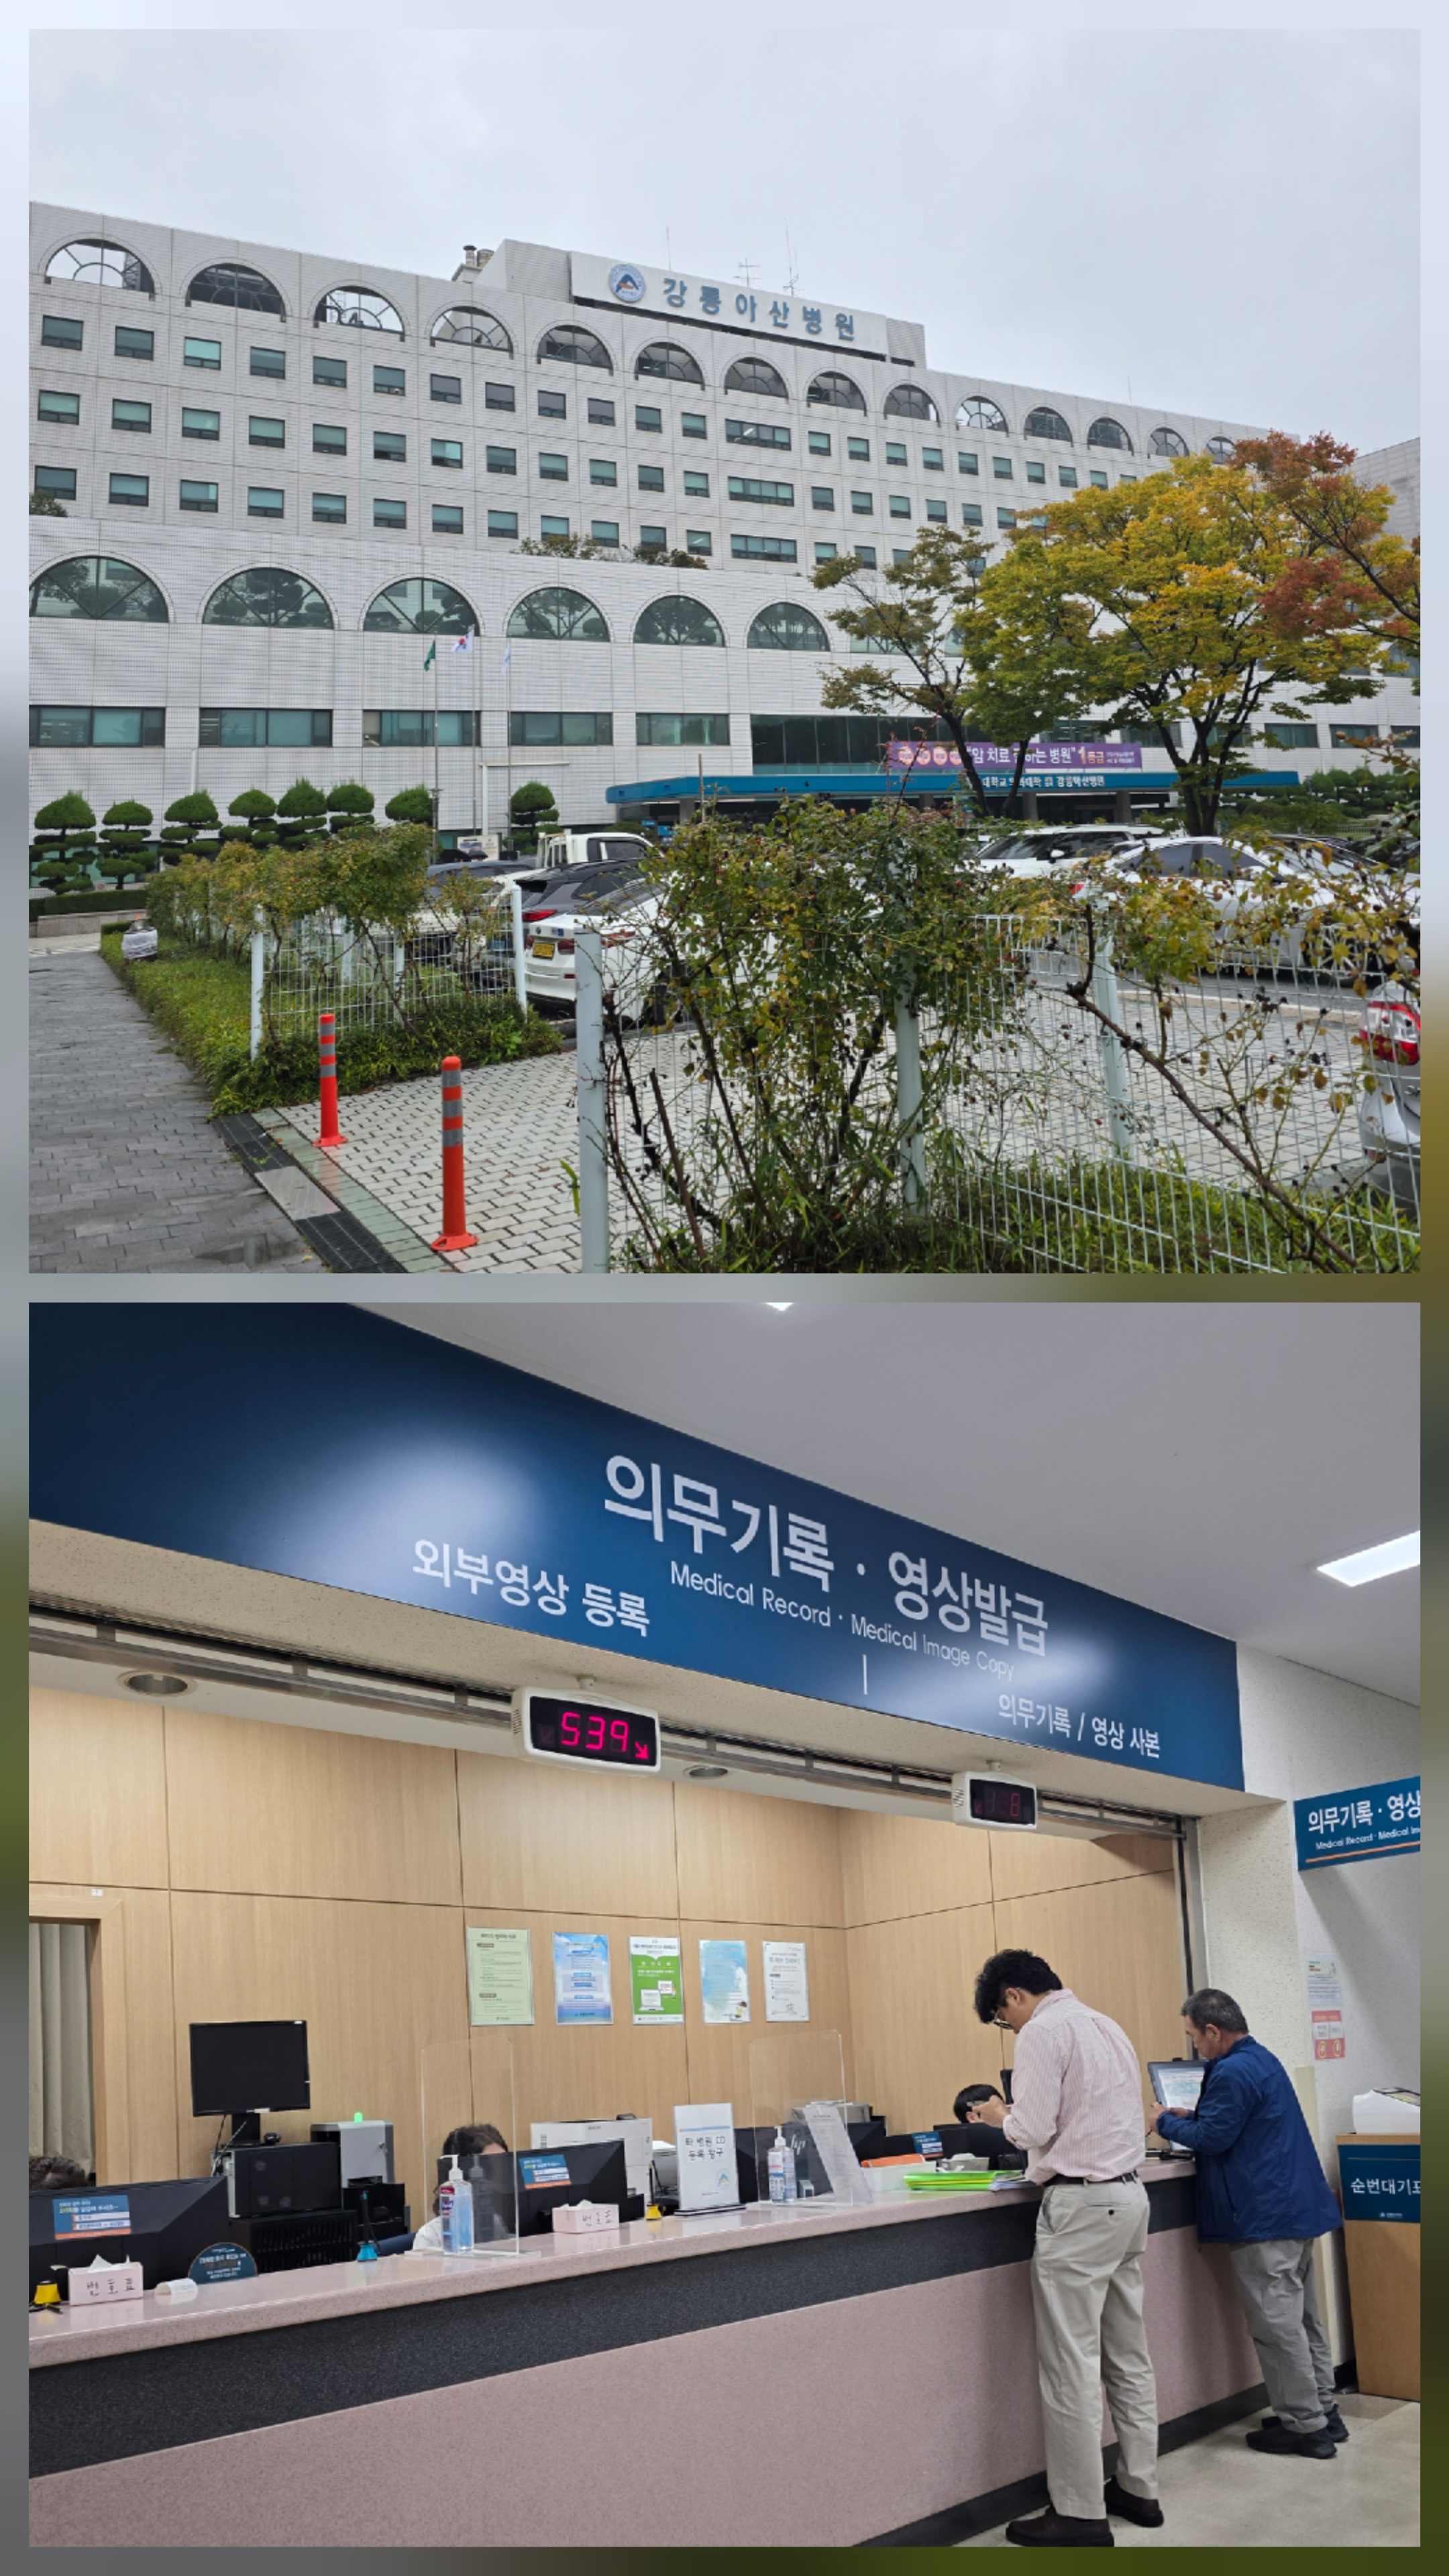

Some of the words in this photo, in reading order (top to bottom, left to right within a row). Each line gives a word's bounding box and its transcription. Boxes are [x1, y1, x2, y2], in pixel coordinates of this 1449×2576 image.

[663, 277, 855, 341] 강릉아산병원
[987, 747, 1011, 763] 치료
[604, 1455, 834, 1592] 의무기록
[888, 1551, 1049, 1656] 영상발급
[413, 1540, 569, 1616] 외부영상
[582, 1582, 651, 1638] 등록
[671, 1560, 753, 1607] Medical
[763, 1586, 831, 1627] Record
[851, 1613, 918, 1652] Medical
[922, 1634, 970, 1668] Image
[975, 1650, 1014, 1682] Copy
[561, 1711, 629, 1752] 539
[998, 1693, 1072, 1738] 의무기록
[1091, 1717, 1124, 1750] 영상
[1129, 1727, 1161, 1759] 사본
[1308, 1799, 1374, 1835] 의무기록
[1316, 1839, 1344, 1849] Medical
[1346, 1833, 1373, 1845] Record
[1379, 1827, 1409, 1839] Medical
